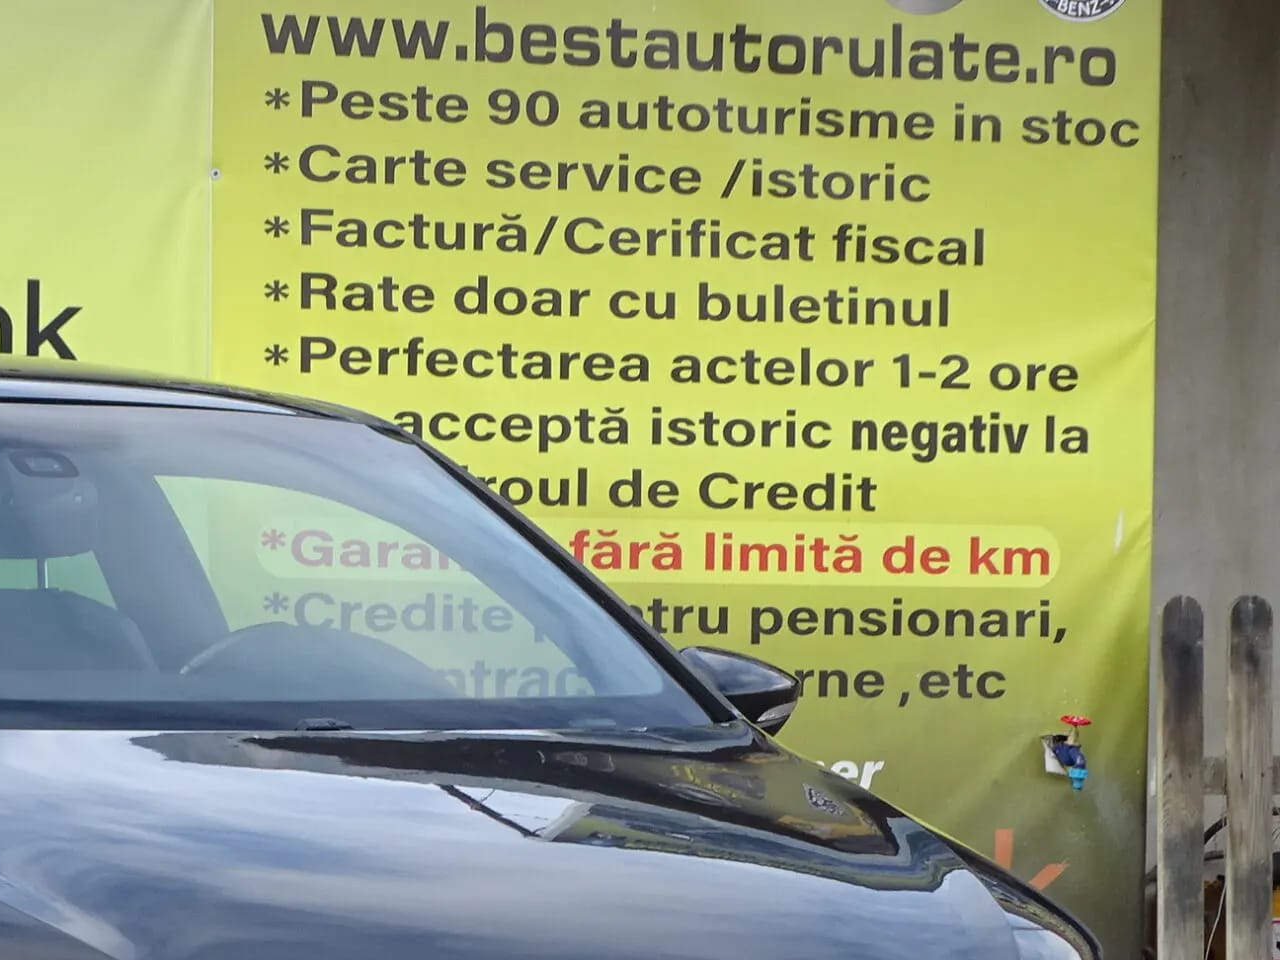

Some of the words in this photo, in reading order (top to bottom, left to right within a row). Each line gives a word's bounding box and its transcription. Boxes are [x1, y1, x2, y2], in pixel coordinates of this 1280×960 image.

[261, 6, 1117, 88] www.bestautorulate.ro
[488, 89, 559, 126] 90
[580, 96, 934, 141] autoturisme
[953, 103, 1001, 143] in
[1022, 110, 1140, 148] stoc
[486, 154, 701, 195] service
[721, 158, 930, 203] /istoric
[832, 224, 985, 267] fiscal
[454, 276, 590, 317] doar
[610, 291, 675, 320] cu
[699, 282, 949, 328] buletinul
[671, 348, 874, 387] actelor
[893, 354, 971, 390] 1-2
[990, 364, 1079, 393] ore
[394, 407, 629, 454] acceptă
[652, 407, 832, 449] istoric
[852, 412, 1029, 464] negativ
[1046, 416, 1089, 455] la
[609, 469, 679, 508] de
[699, 473, 878, 513] Credit
[569, 529, 683, 571] fără
[705, 532, 863, 574] limită
[883, 536, 951, 575] de
[970, 537, 1050, 576] km
[750, 598, 1067, 644] pensionari,
